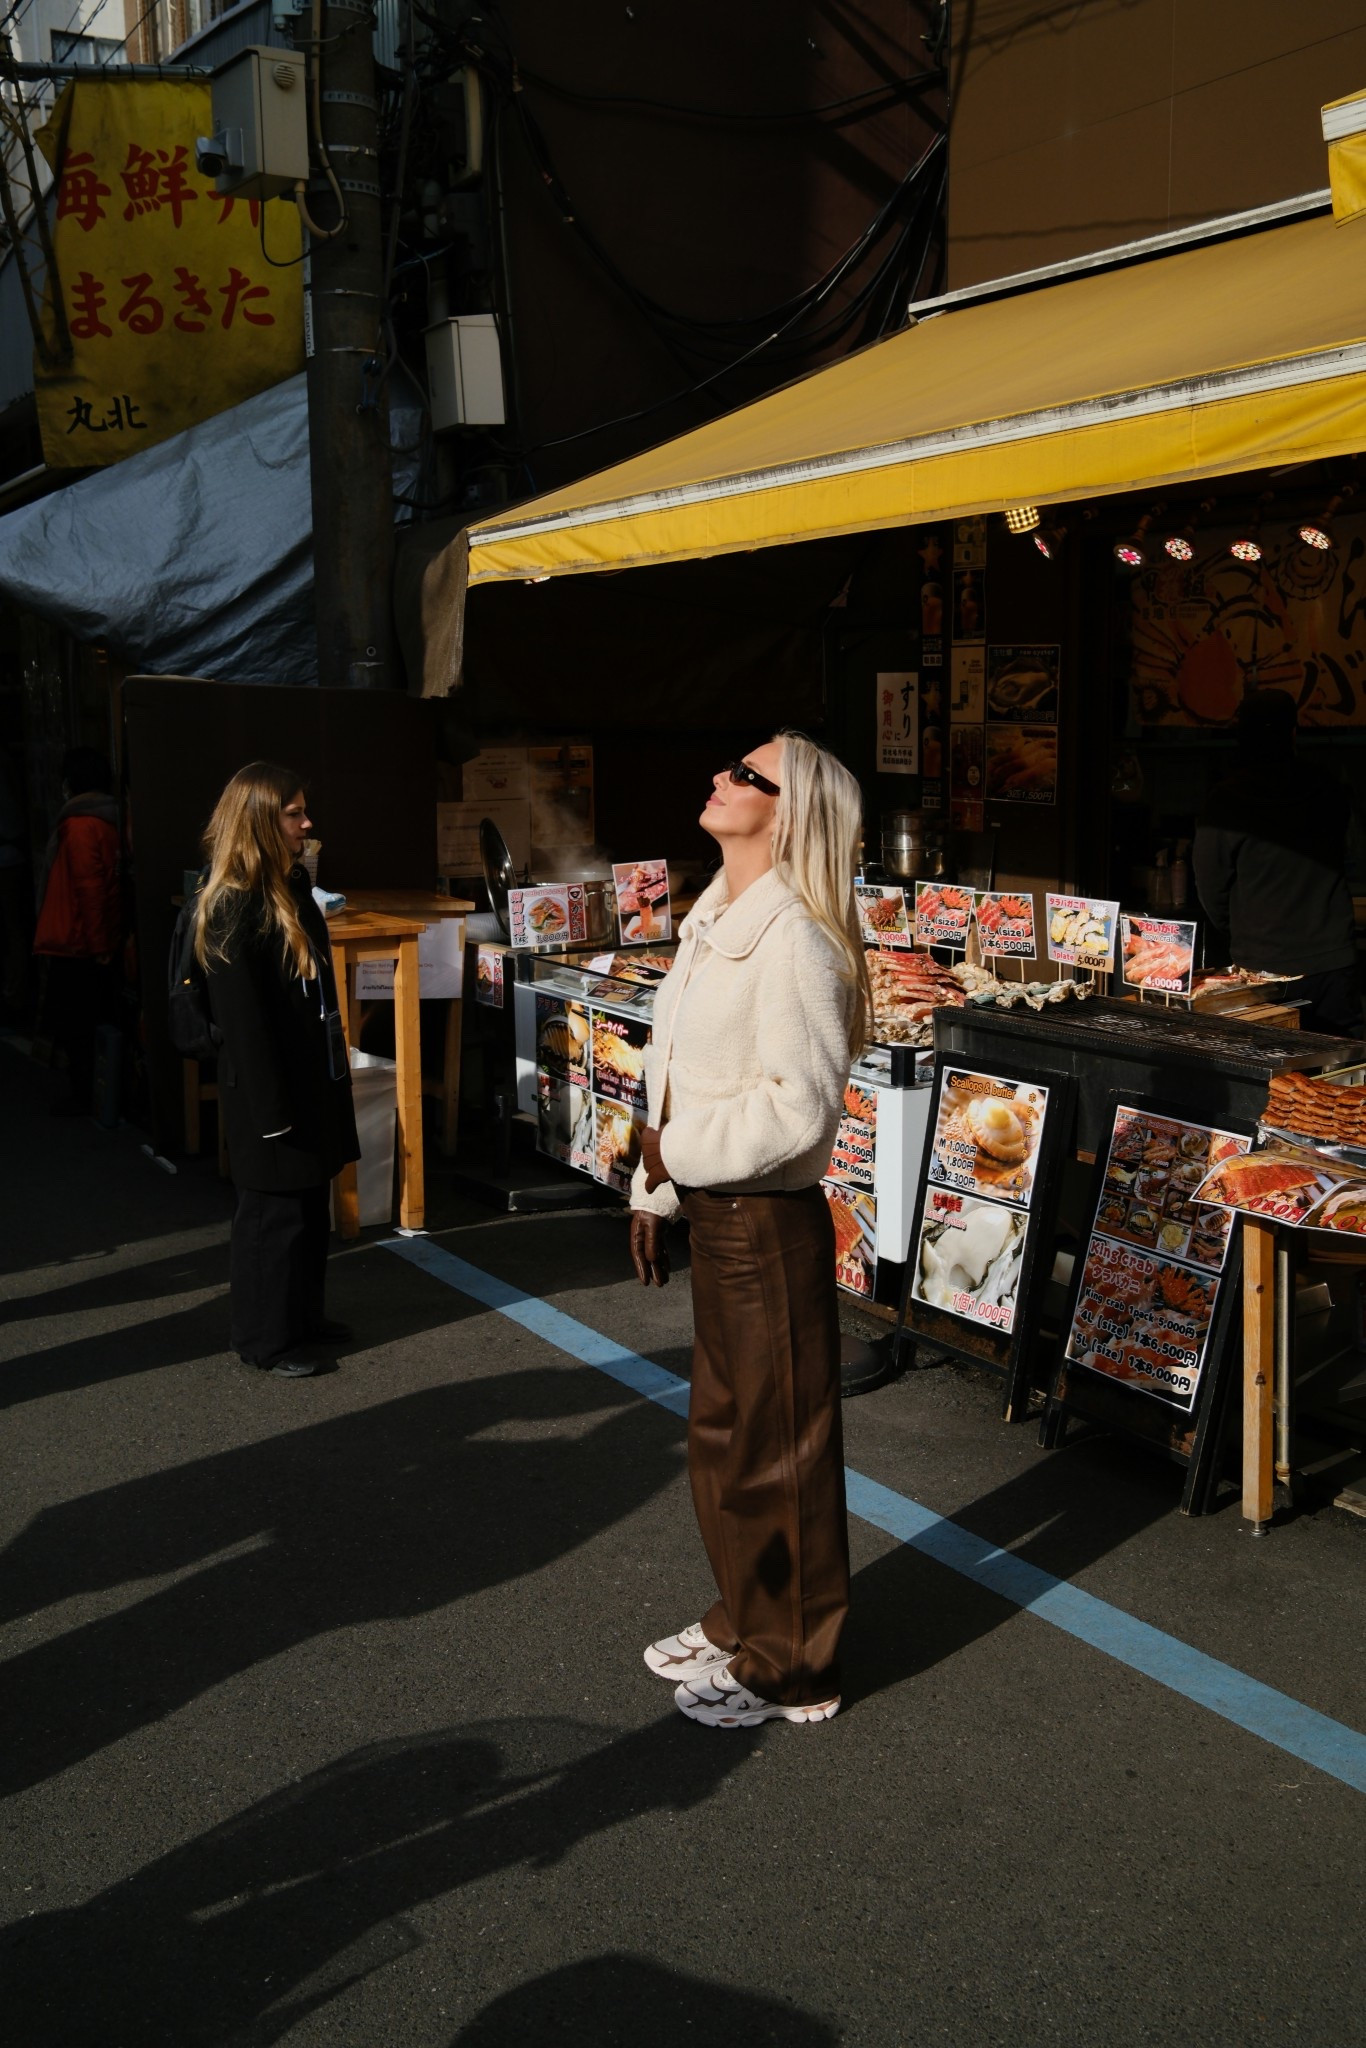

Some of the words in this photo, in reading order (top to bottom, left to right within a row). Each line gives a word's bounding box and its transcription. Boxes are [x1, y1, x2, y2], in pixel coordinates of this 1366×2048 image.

[56, 143, 260, 232] 海鮮
[70, 267, 275, 339] まるきた
[67, 395, 148, 434] 丸北
[901, 681, 914, 739] すり
[935, 917, 959, 928] (size)
[998, 927, 1025, 937] (size)
[950, 1075, 983, 1094] Scallops
[984, 1082, 990, 1094] &
[991, 1084, 1017, 1100] butter
[837, 1139, 873, 1160] 本6,500円
[939, 1137, 946, 1146] M
[1090, 1239, 1119, 1264] King
[1121, 1254, 1154, 1274] crab
[1092, 1265, 1141, 1294] タラバガニ
[952, 1293, 1012, 1326] 1個1,000円
[1085, 1288, 1103, 1304] King
[1106, 1298, 1125, 1311] crab
[1129, 1305, 1154, 1322] 1pack
[1158, 1318, 1195, 1339] 5,000円
[1081, 1310, 1093, 1323] 4L
[1098, 1315, 1129, 1339] (size)
[1134, 1332, 1197, 1366] 1本6,500円
[1076, 1333, 1087, 1346] 5L
[1091, 1339, 1124, 1363] (size)
[1128, 1356, 1191, 1391] 1本8,000円
